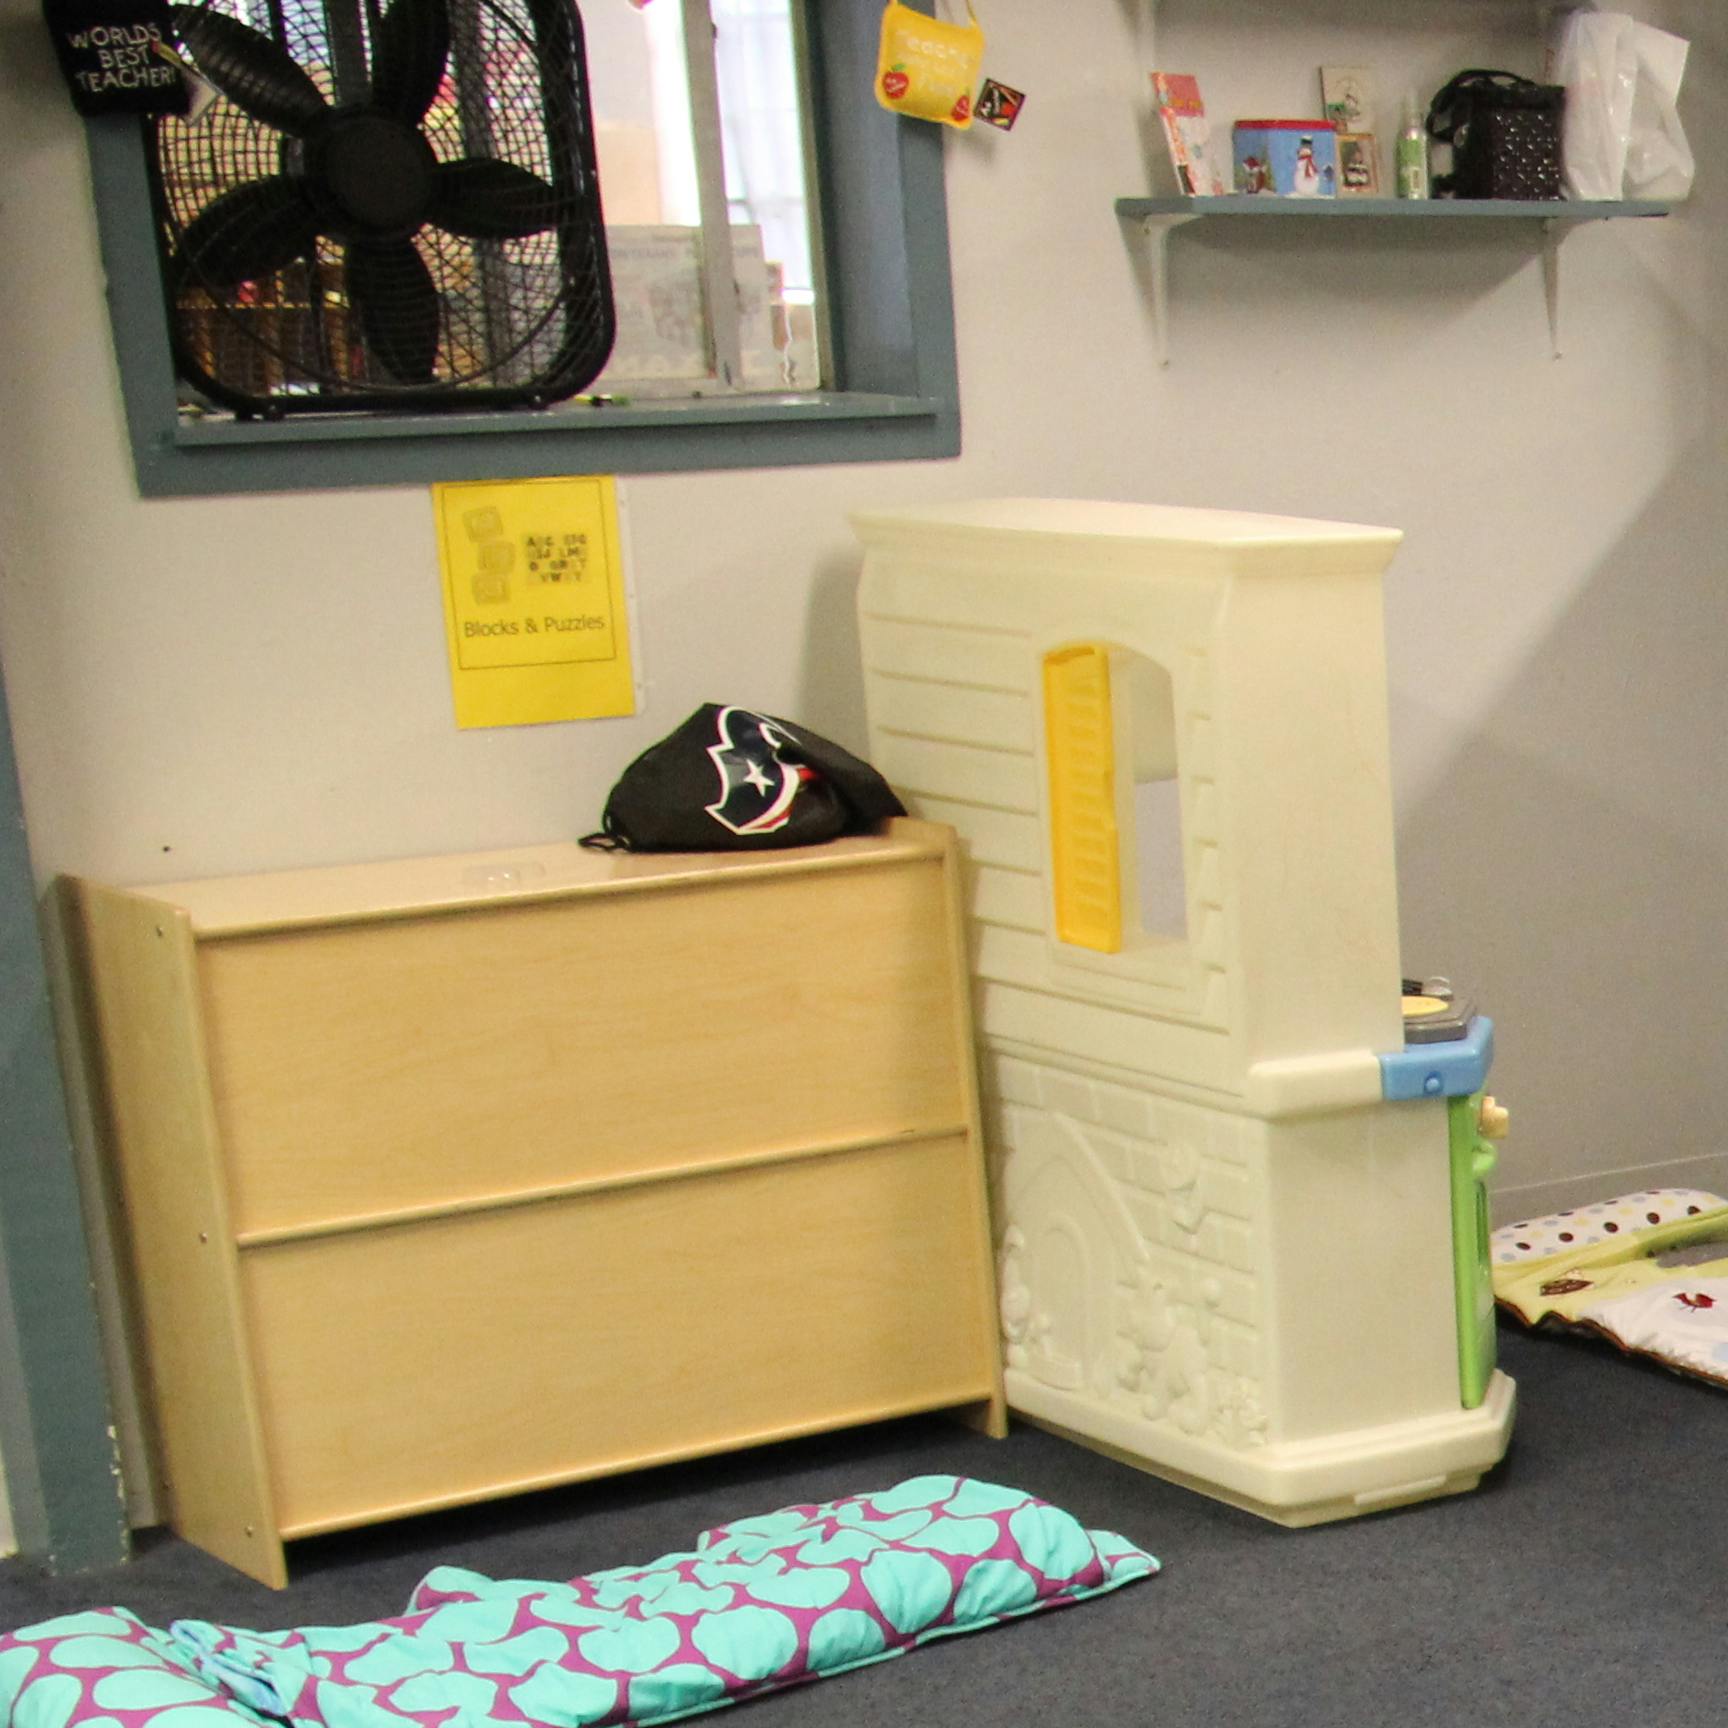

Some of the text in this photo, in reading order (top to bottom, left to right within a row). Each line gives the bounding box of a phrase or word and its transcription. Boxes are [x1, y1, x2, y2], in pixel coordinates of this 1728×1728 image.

[99, 45, 149, 68] BEST
[75, 66, 176, 91] TEACHER!
[464, 615, 605, 638] Blocks & Puzzles
